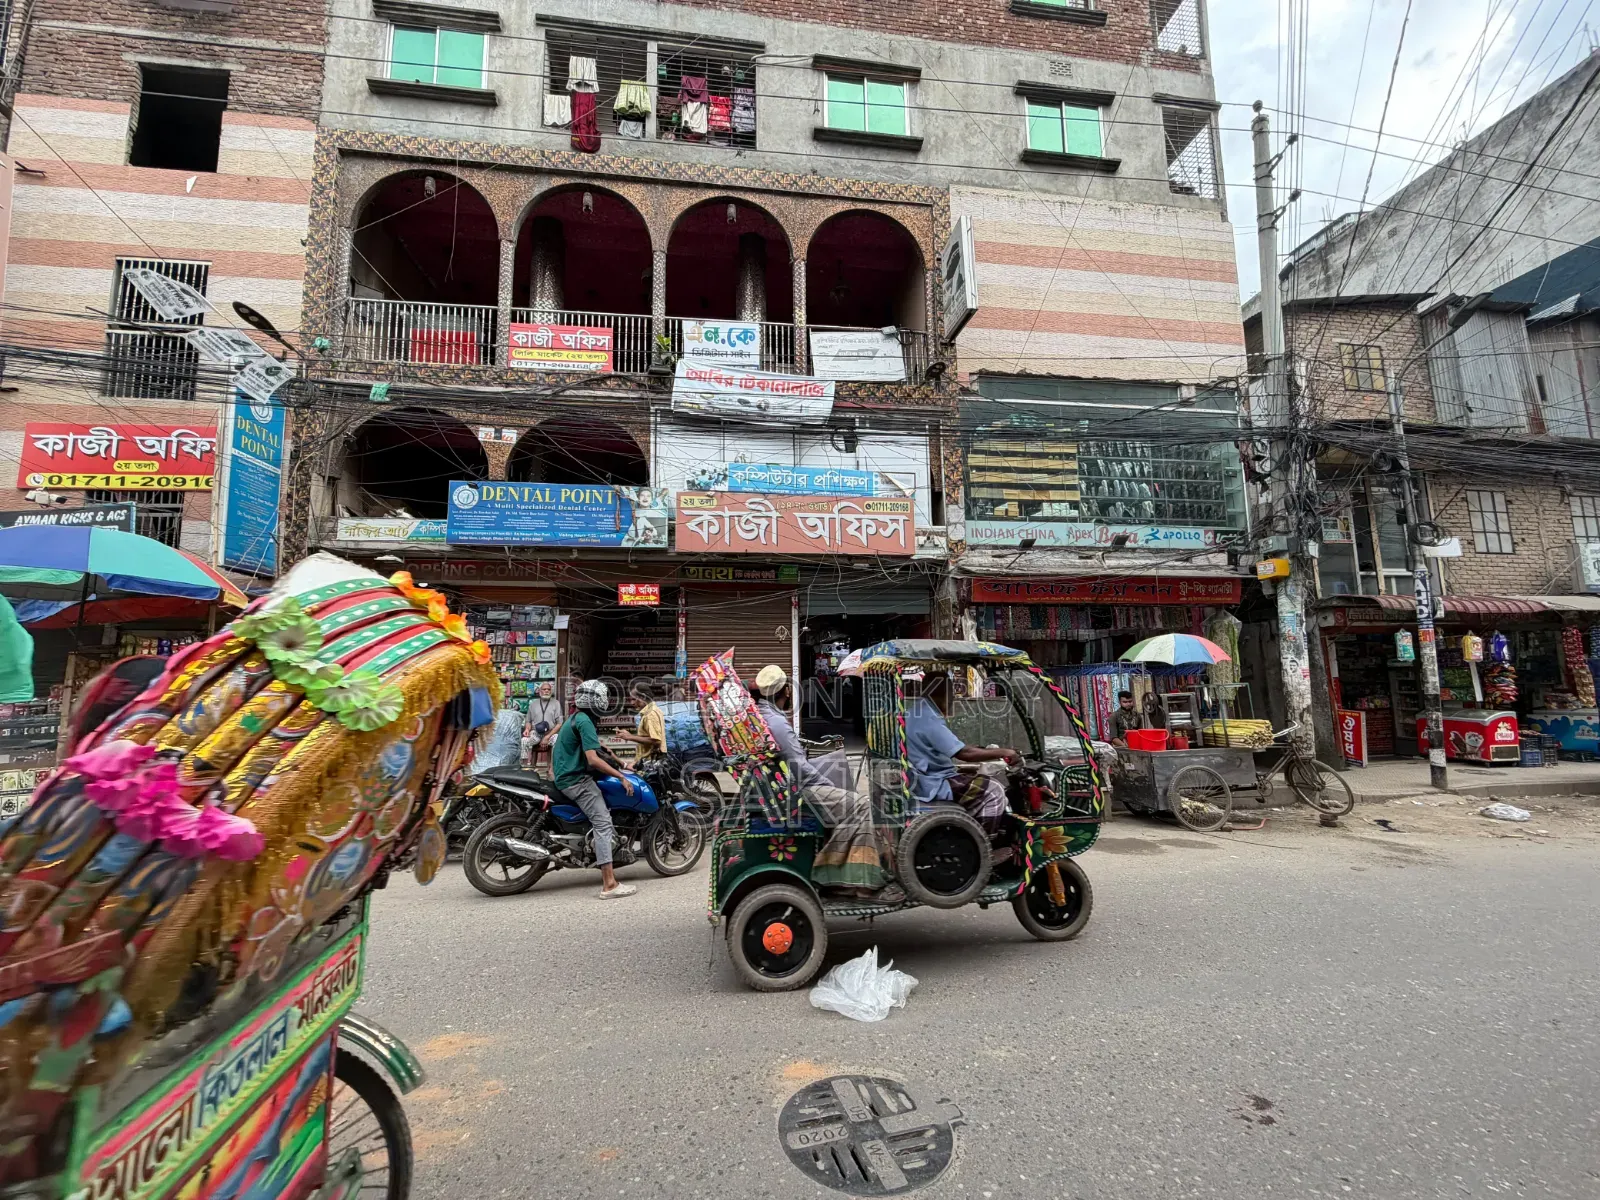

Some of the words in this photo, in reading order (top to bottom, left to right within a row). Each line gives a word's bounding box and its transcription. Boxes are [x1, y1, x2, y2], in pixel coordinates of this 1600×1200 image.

[510, 326, 554, 348] কাজী
[559, 329, 611, 350] অফিস
[236, 415, 281, 450] DENTAL
[29, 427, 125, 459] কাজী
[135, 429, 216, 461] অফি
[240, 435, 276, 462] POINT
[732, 465, 810, 489] কম্পিউটার
[813, 471, 869, 492] প্রশিক্ষণ
[481, 485, 556, 503] DENTAL
[560, 488, 614, 505] POINT
[60, 510, 95, 525] KICKS
[96, 510, 104, 521] &
[516, 503, 560, 511] Specialized
[681, 498, 783, 545] কাজী
[793, 501, 909, 549] অফিস
[970, 527, 1015, 540] INDIAN
[1017, 528, 1055, 541] CHINA
[1162, 530, 1201, 541] APOLLO
[483, 564, 571, 578] COMPLEX
[619, 584, 636, 595] কাজী
[638, 585, 659, 595] অফিস
[1343, 715, 1356, 755] ঔষধ
[798, 1124, 849, 1145] 2020
